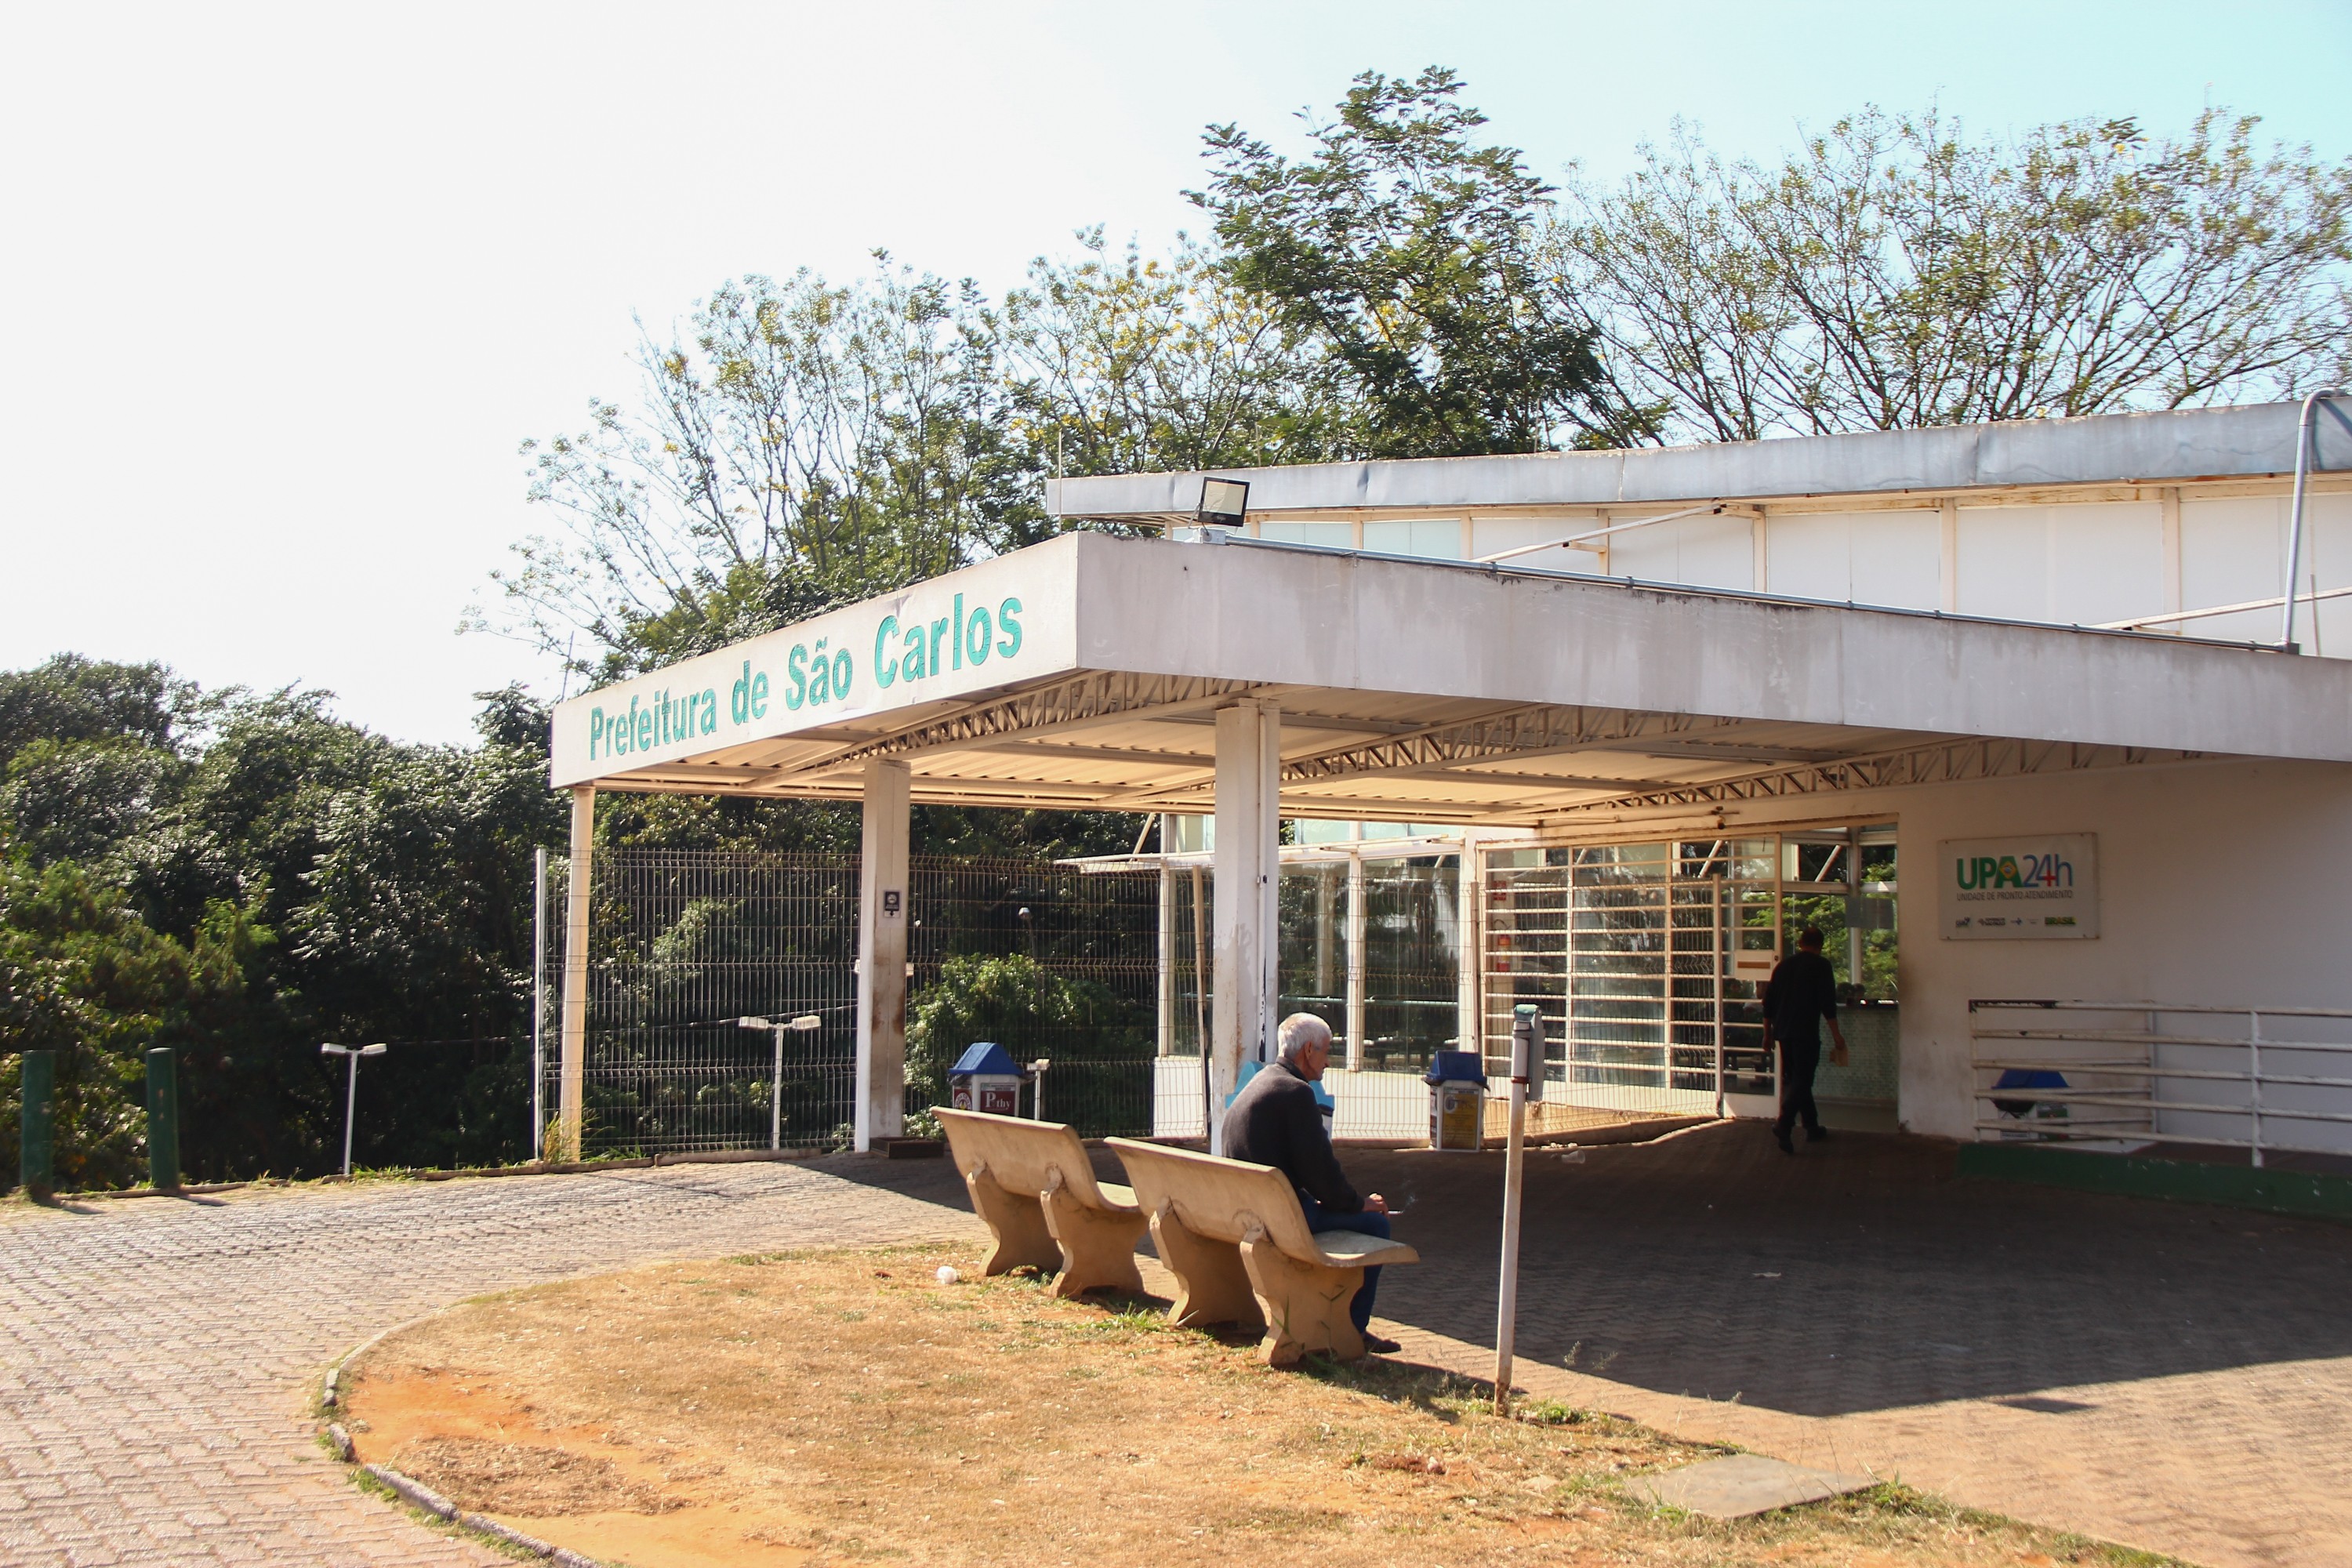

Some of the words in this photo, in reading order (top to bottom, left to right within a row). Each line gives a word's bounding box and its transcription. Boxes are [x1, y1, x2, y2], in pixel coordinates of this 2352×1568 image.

[590, 688, 716, 760] Prefeitura
[731, 661, 768, 724] de
[786, 636, 853, 710] São
[874, 593, 1022, 688] Carlos
[1957, 892, 1985, 901] UNIDADE
[1997, 891, 2023, 899] PRONTO
[2025, 890, 2073, 899] ATENDIMENTO
